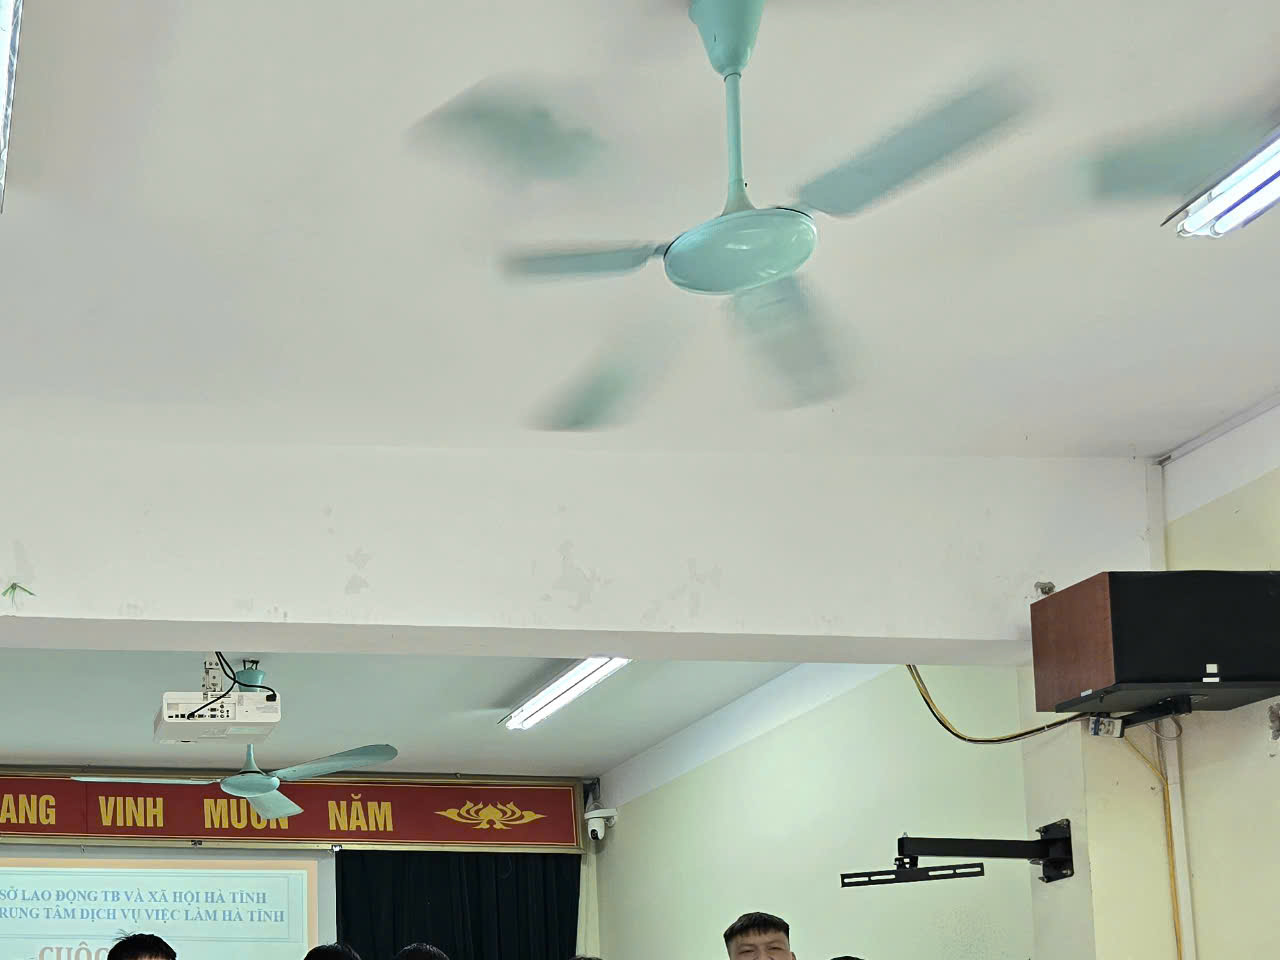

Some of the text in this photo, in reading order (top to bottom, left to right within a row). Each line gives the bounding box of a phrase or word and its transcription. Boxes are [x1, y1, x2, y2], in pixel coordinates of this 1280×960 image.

[98, 796, 163, 827] VINH
[327, 793, 393, 832] NĂM
[0, 886, 18, 901] SỞ
[21, 890, 52, 901] LAO
[55, 889, 98, 904] ĐỘNG
[101, 890, 120, 901] TB
[124, 888, 143, 902] VÀ
[148, 888, 168, 903] XÃ
[173, 890, 201, 906] HỘI
[204, 887, 225, 904] HÀ
[43, 905, 76, 919] TÂM
[80, 908, 117, 922] DỊCH
[120, 909, 141, 923] VỤ
[144, 908, 181, 923] VIỆC
[184, 907, 217, 921] LÀM
[222, 907, 243, 922] HÀ
